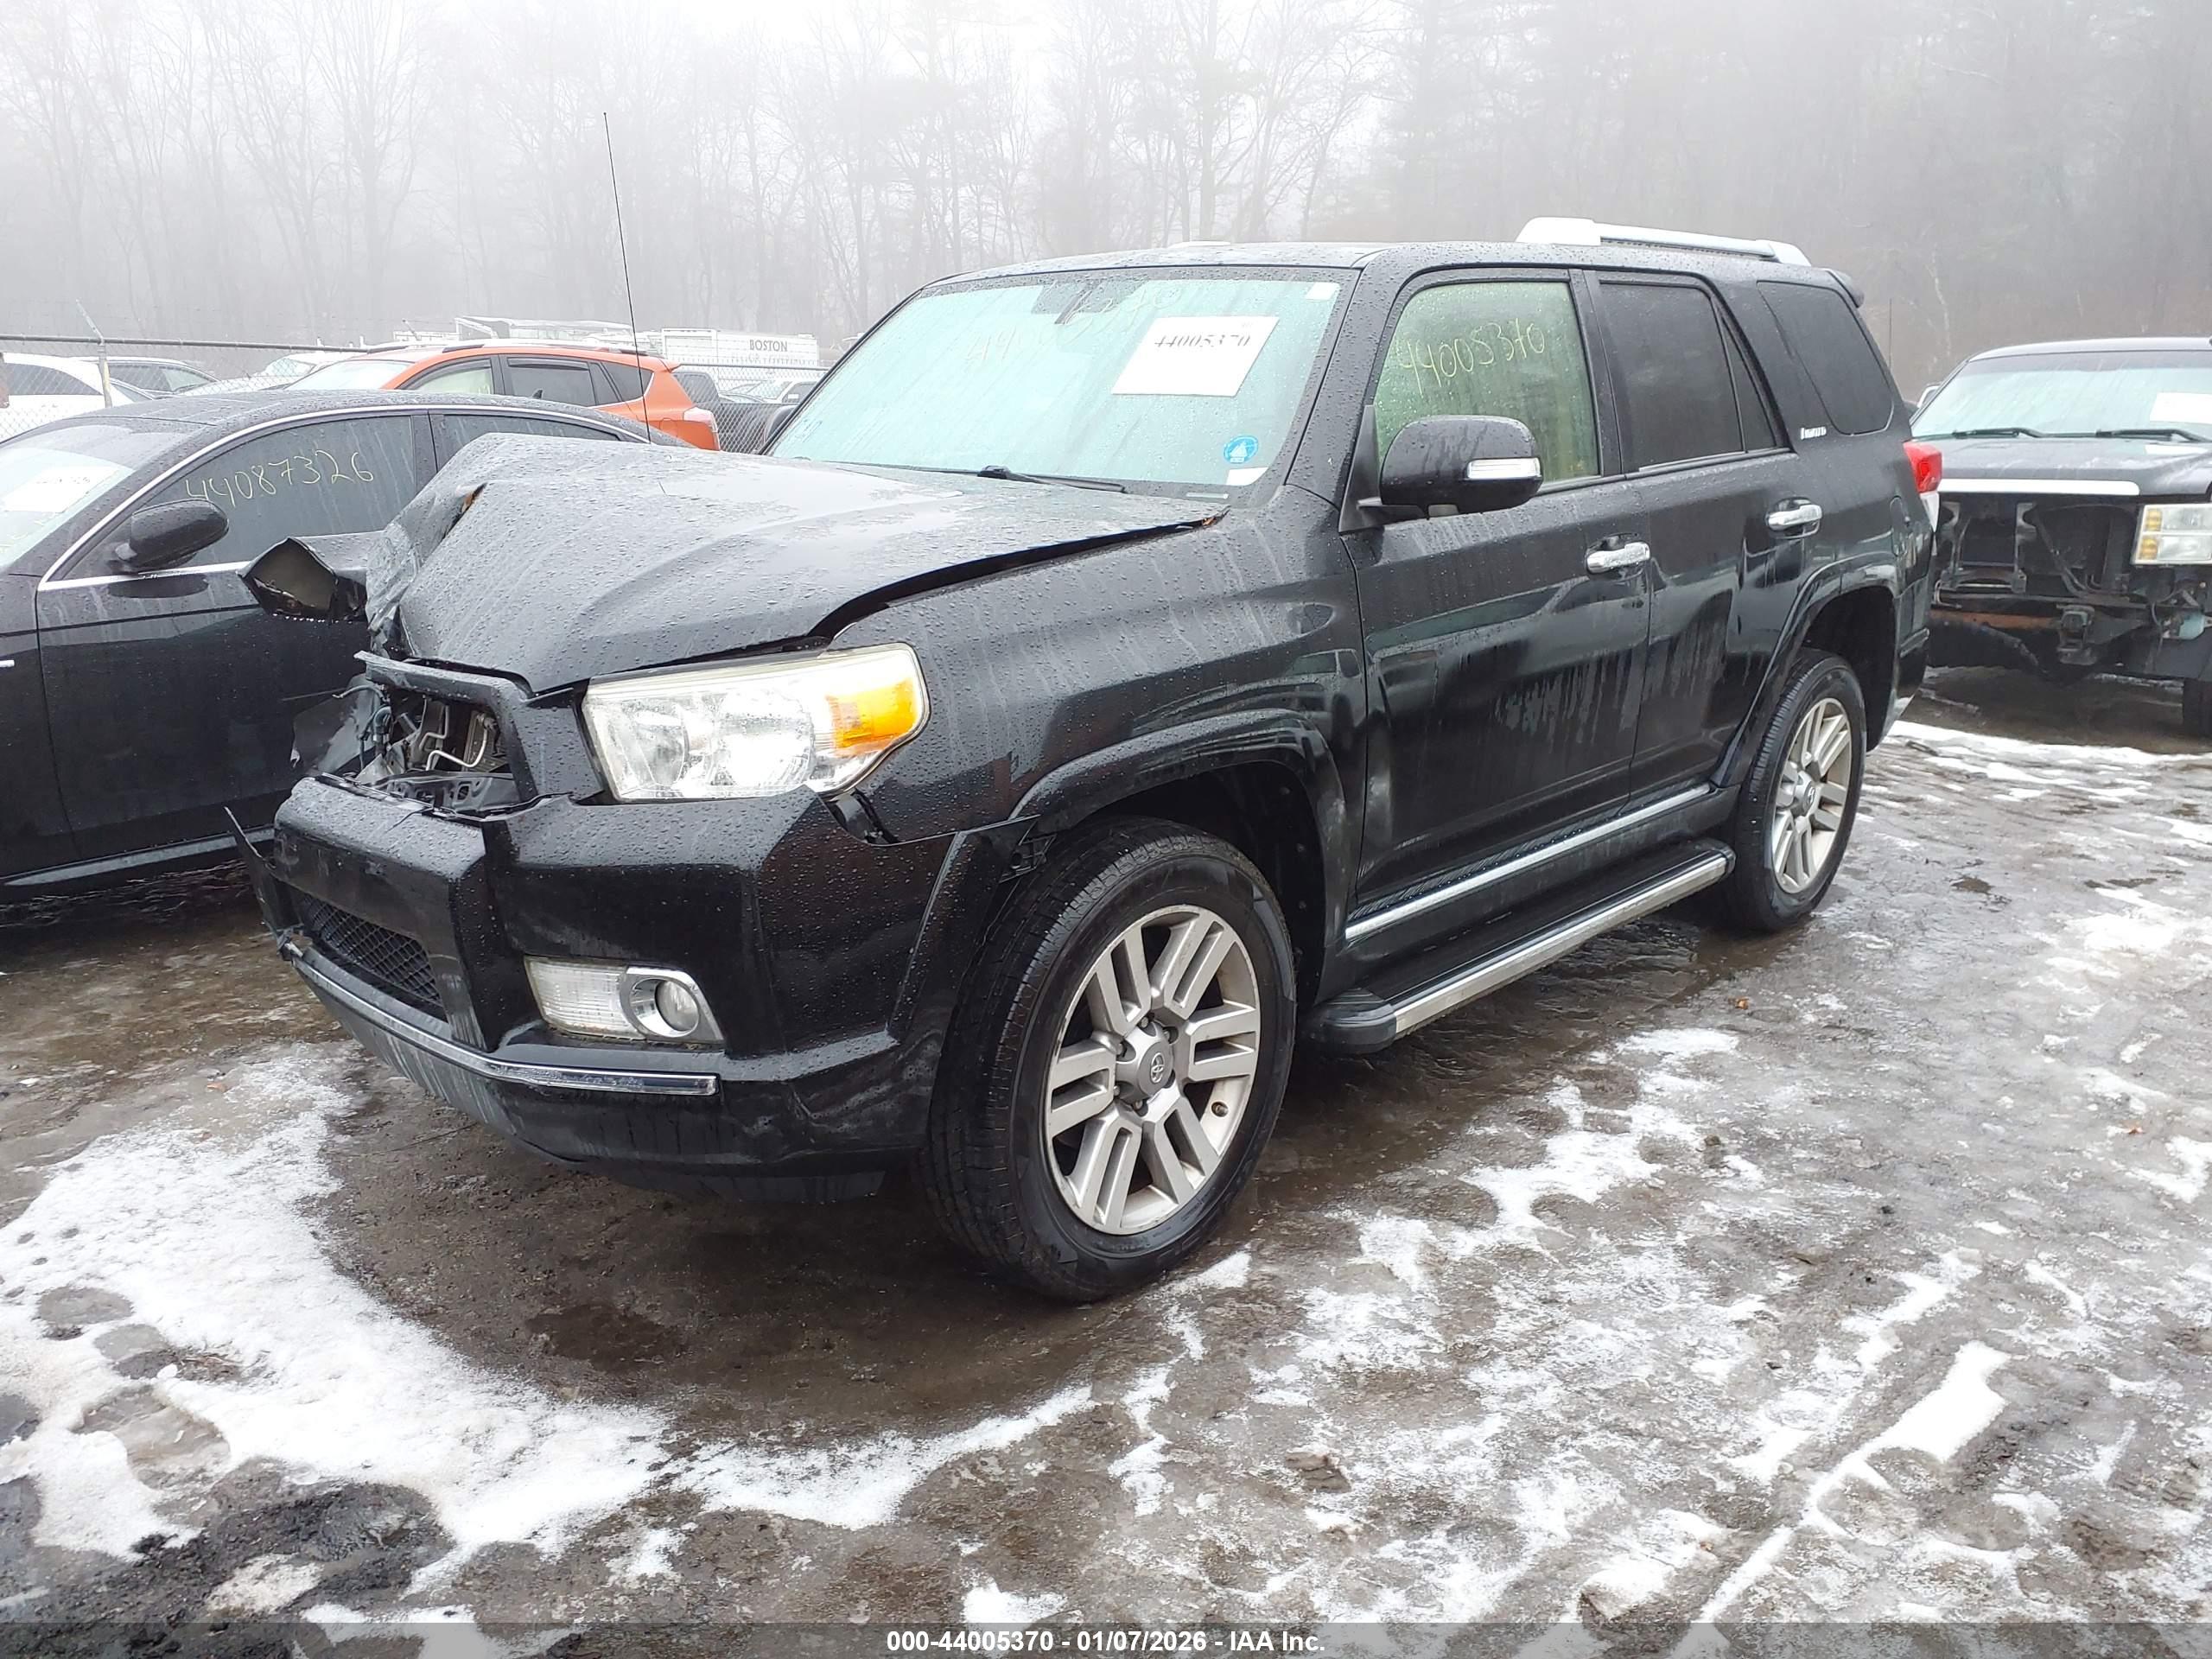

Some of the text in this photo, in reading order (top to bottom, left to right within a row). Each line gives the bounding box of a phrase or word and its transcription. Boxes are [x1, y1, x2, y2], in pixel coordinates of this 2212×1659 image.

[749, 340, 788, 353] BOSTON
[1396, 317, 1545, 398] 44005370
[185, 449, 374, 508] 44087326
